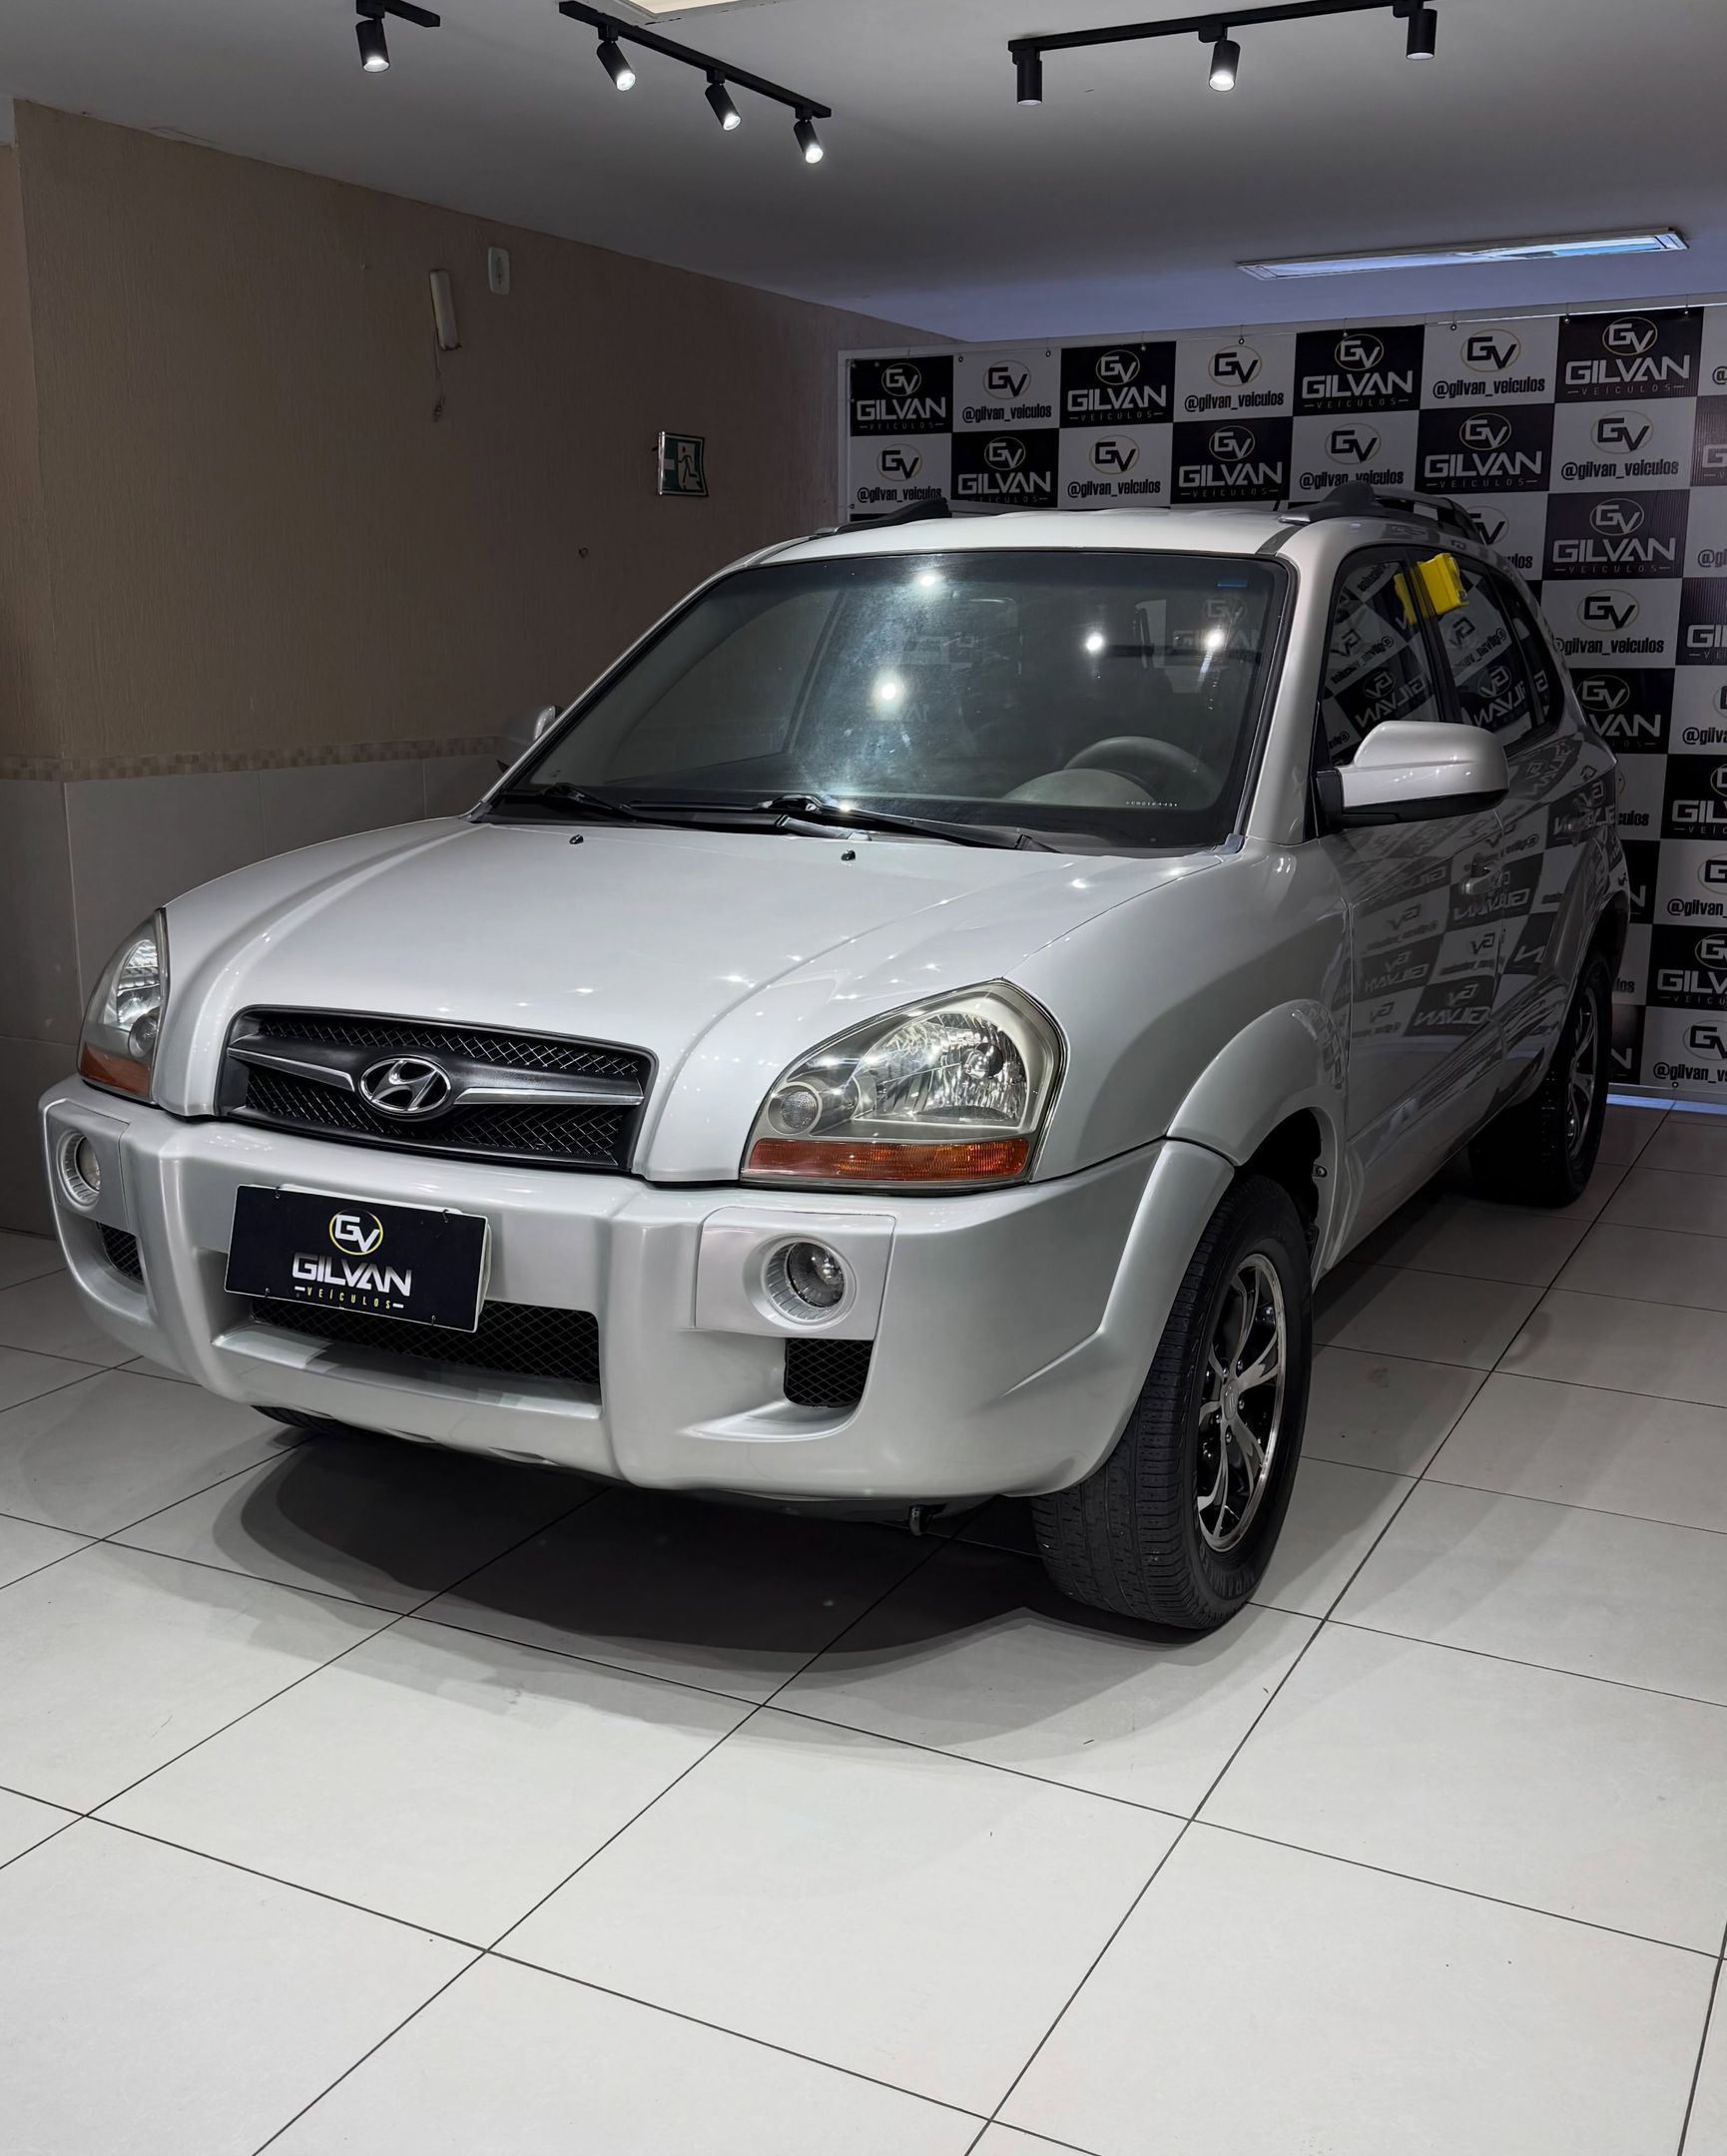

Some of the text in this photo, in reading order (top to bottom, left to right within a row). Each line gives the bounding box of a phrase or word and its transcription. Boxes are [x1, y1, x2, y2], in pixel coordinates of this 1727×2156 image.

[1467, 336, 1517, 368] GV
[1608, 323, 1654, 352] GV
[1214, 352, 1259, 383] GV
[1340, 339, 1381, 368] GV
[885, 368, 918, 394] GV
[988, 366, 1028, 397] GV
[1100, 355, 1137, 382] GV
[1565, 354, 1690, 384] GILVAN
[1067, 384, 1167, 412] GILVAN
[1302, 369, 1414, 399] GILVAN
[1434, 376, 1545, 398] @gilvan_veiculos
[856, 396, 946, 421] GILVAN
[962, 403, 1051, 423] @gilvan_veiculos
[1185, 390, 1284, 412] @gilvan_veiculos
[1214, 431, 1252, 460] GV
[1332, 430, 1378, 462] GV
[1464, 418, 1508, 448] GV
[1597, 417, 1650, 451] GV
[882, 450, 919, 479] GV
[988, 442, 1022, 468] GV
[1095, 441, 1136, 472] GV
[1424, 450, 1542, 478] GILVAN
[1561, 458, 1679, 480] @gilvan_veiculos
[957, 471, 1051, 494] GILVAN
[1067, 479, 1161, 498] @gilvan_veiculos
[1178, 461, 1283, 488] GILVAN
[857, 486, 941, 503] @gilvan_veiculos
[1596, 504, 1640, 534] GV
[1552, 537, 1676, 564] GILVAN
[1584, 596, 1636, 629] GV
[1581, 681, 1626, 710] GV
[1588, 714, 1661, 737] VAN
[1657, 968, 1727, 994] GILV
[334, 1214, 380, 1253] GV
[291, 1253, 412, 1297] GILVAN
